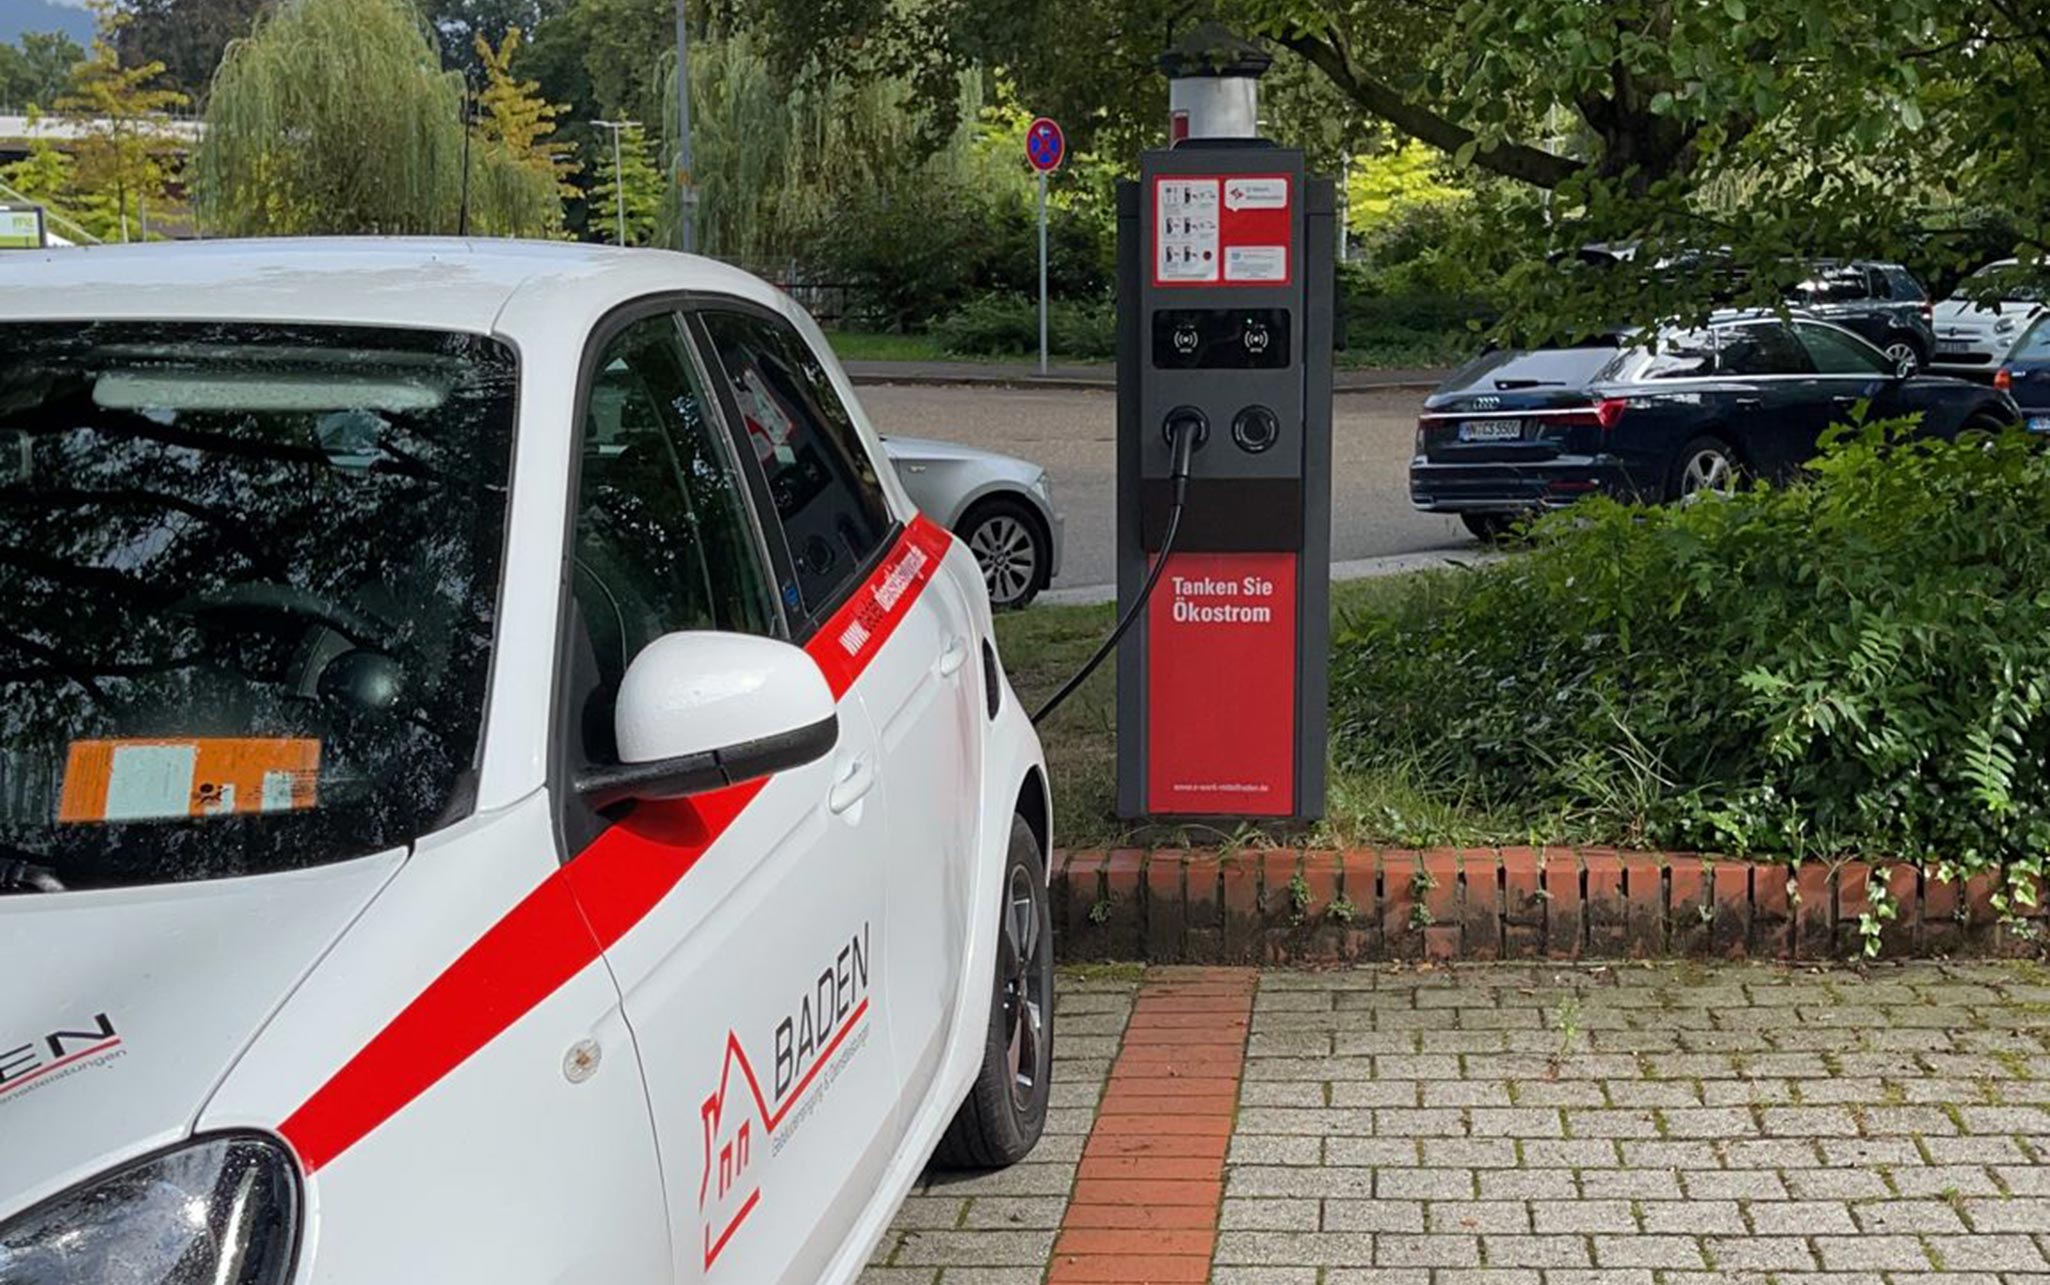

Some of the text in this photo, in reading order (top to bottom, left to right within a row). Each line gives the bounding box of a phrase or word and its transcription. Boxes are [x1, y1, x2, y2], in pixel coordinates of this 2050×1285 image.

[1172, 577, 1273, 596] Tanken Sie
[1172, 597, 1271, 623] Ökostrom
[775, 921, 869, 1102] BADEN
